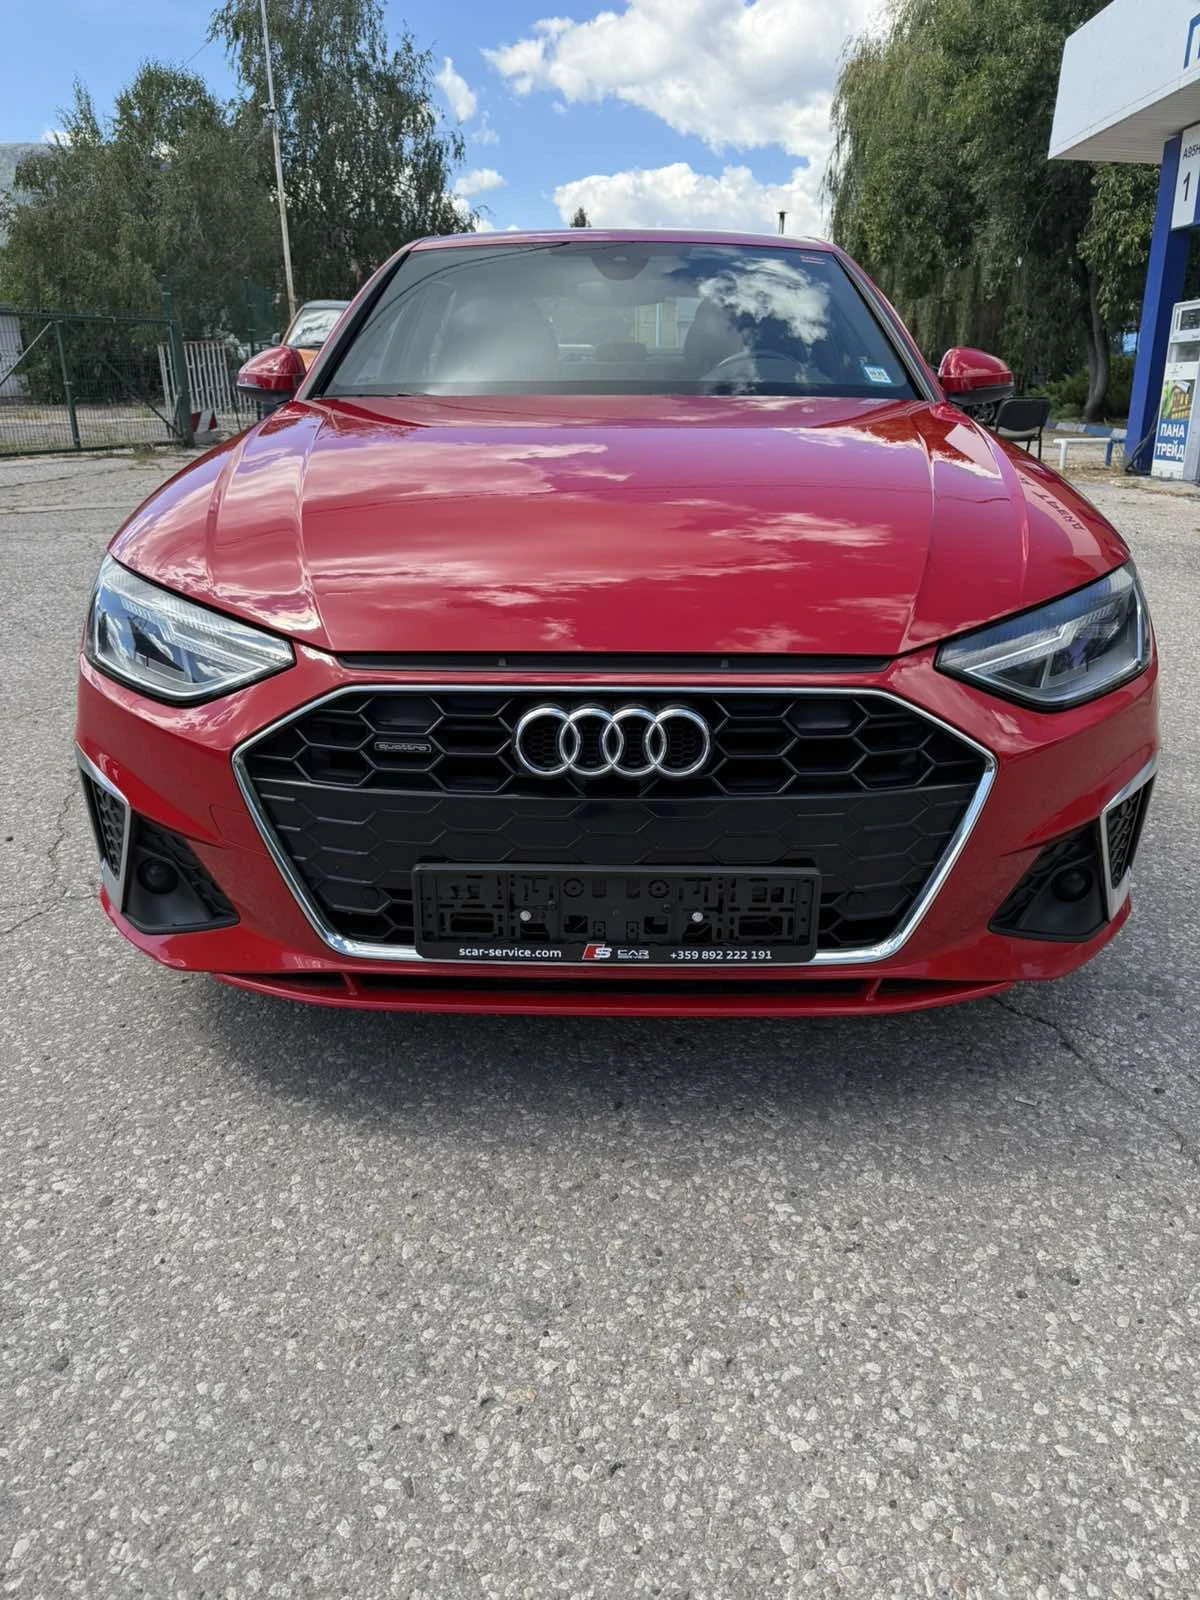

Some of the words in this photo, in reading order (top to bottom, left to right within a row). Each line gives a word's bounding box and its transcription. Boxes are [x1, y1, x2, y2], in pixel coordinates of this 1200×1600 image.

[1183, 171, 1191, 201] 1
[1160, 423, 1185, 438] ПАНА
[1156, 439, 1185, 461] ТРЕЙД
[379, 744, 427, 752] quattro
[458, 947, 562, 959] scar-service.com
[669, 950, 699, 961] +359
[701, 950, 724, 961] 892
[726, 950, 748, 961] 222
[750, 950, 773, 961] 191
